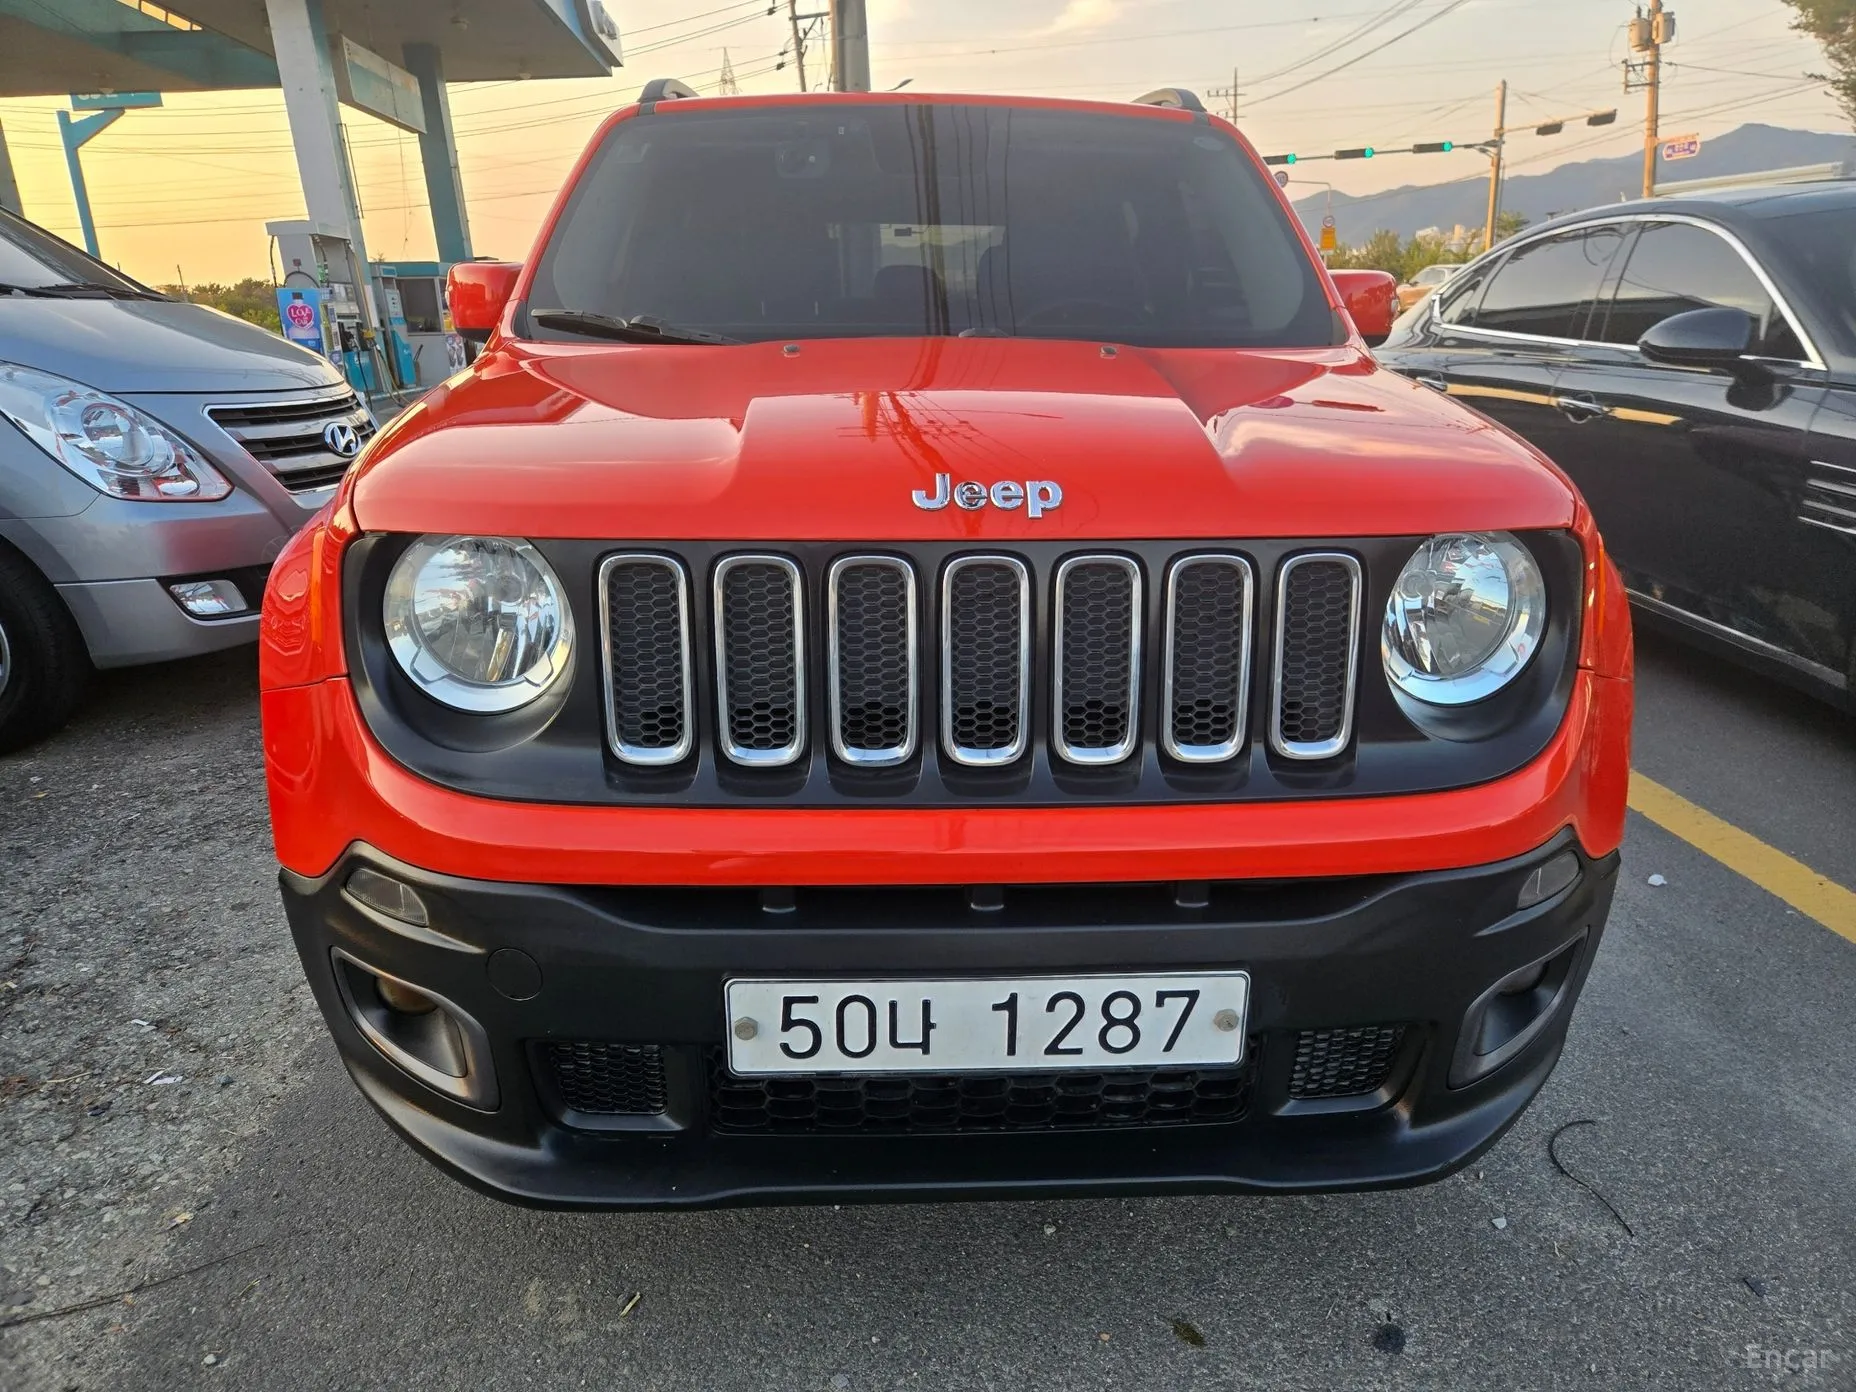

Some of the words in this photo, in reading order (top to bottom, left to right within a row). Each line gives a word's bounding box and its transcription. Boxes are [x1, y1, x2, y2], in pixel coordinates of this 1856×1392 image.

[912, 473, 1063, 519] Jeep
[779, 994, 937, 1060] 50나
[991, 990, 1201, 1057] 1287
